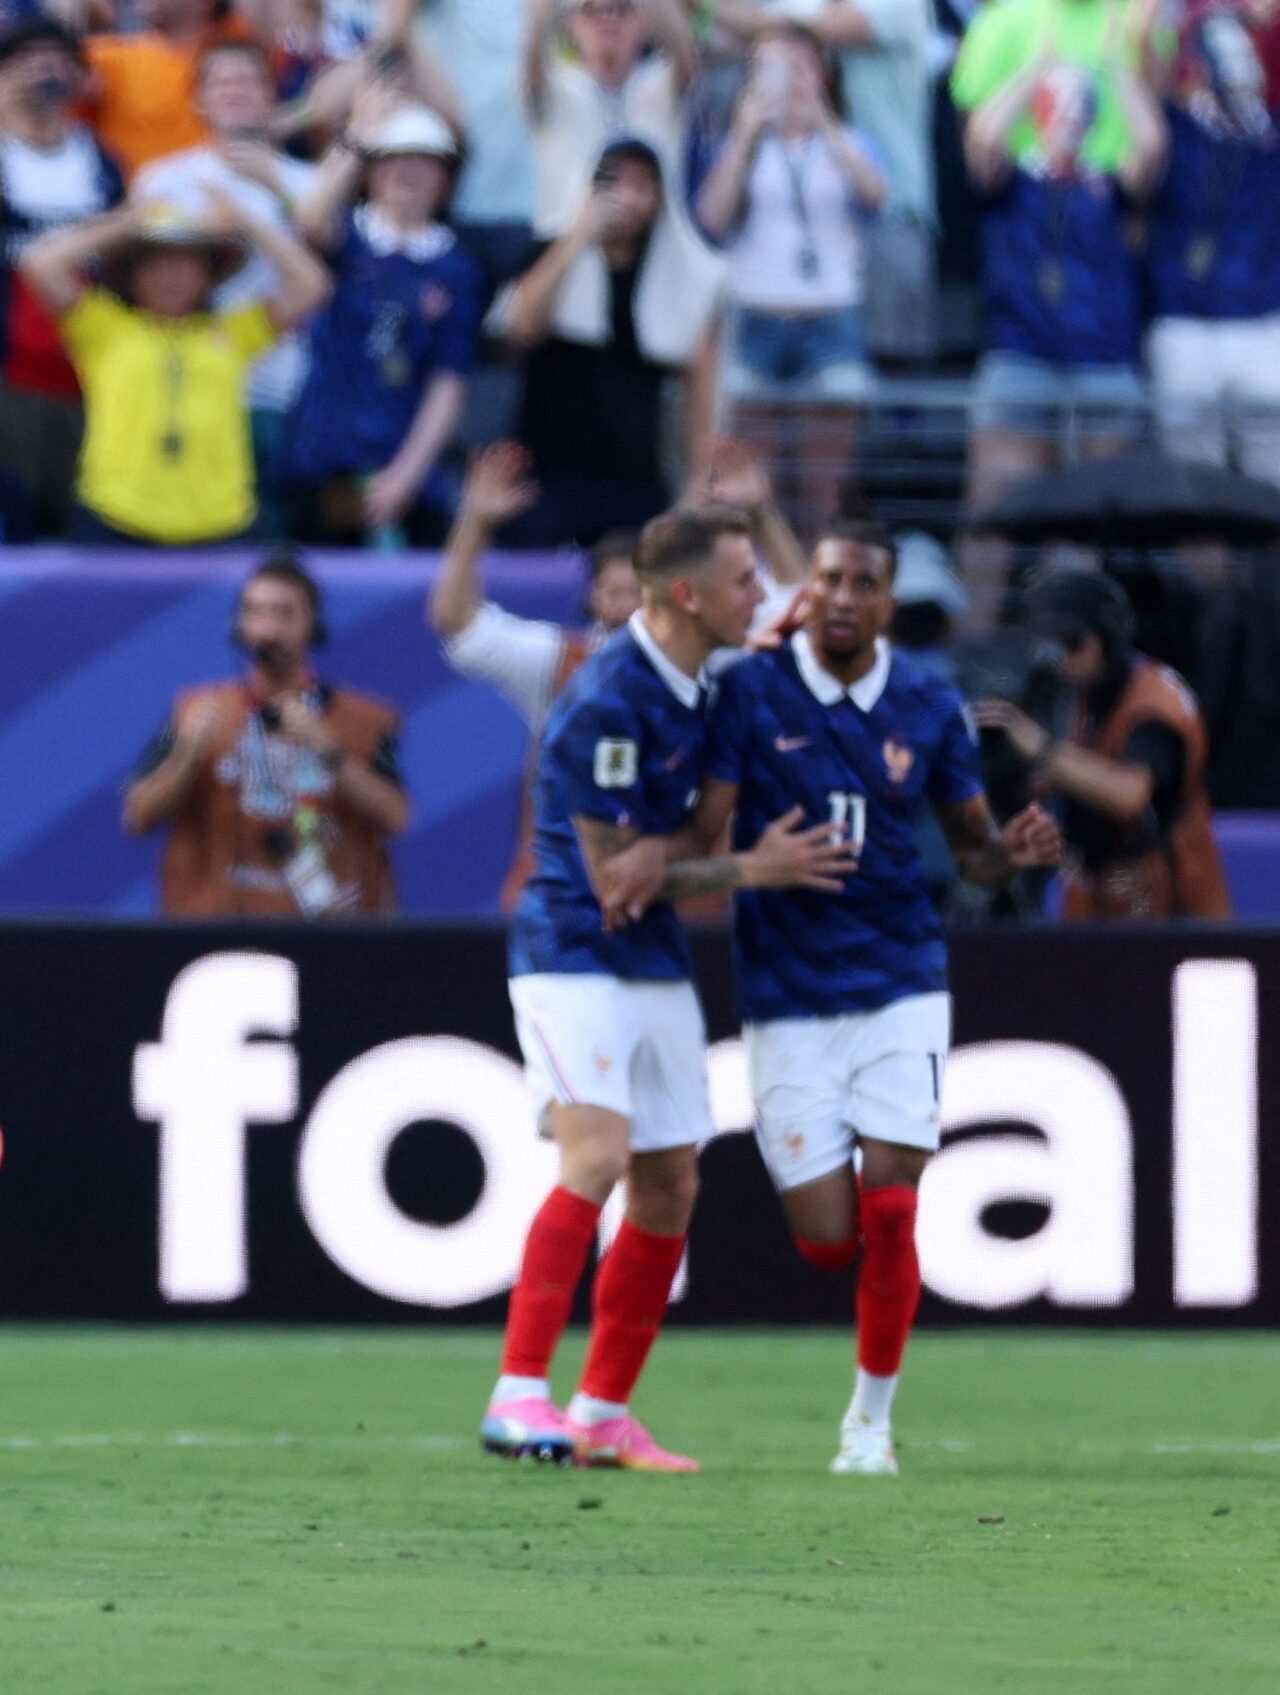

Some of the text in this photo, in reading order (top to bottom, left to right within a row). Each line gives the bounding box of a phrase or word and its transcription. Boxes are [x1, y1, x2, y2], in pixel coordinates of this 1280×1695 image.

[827, 791, 867, 857] 11
[926, 1051, 945, 1104] 1
[913, 958, 1259, 1309] al
